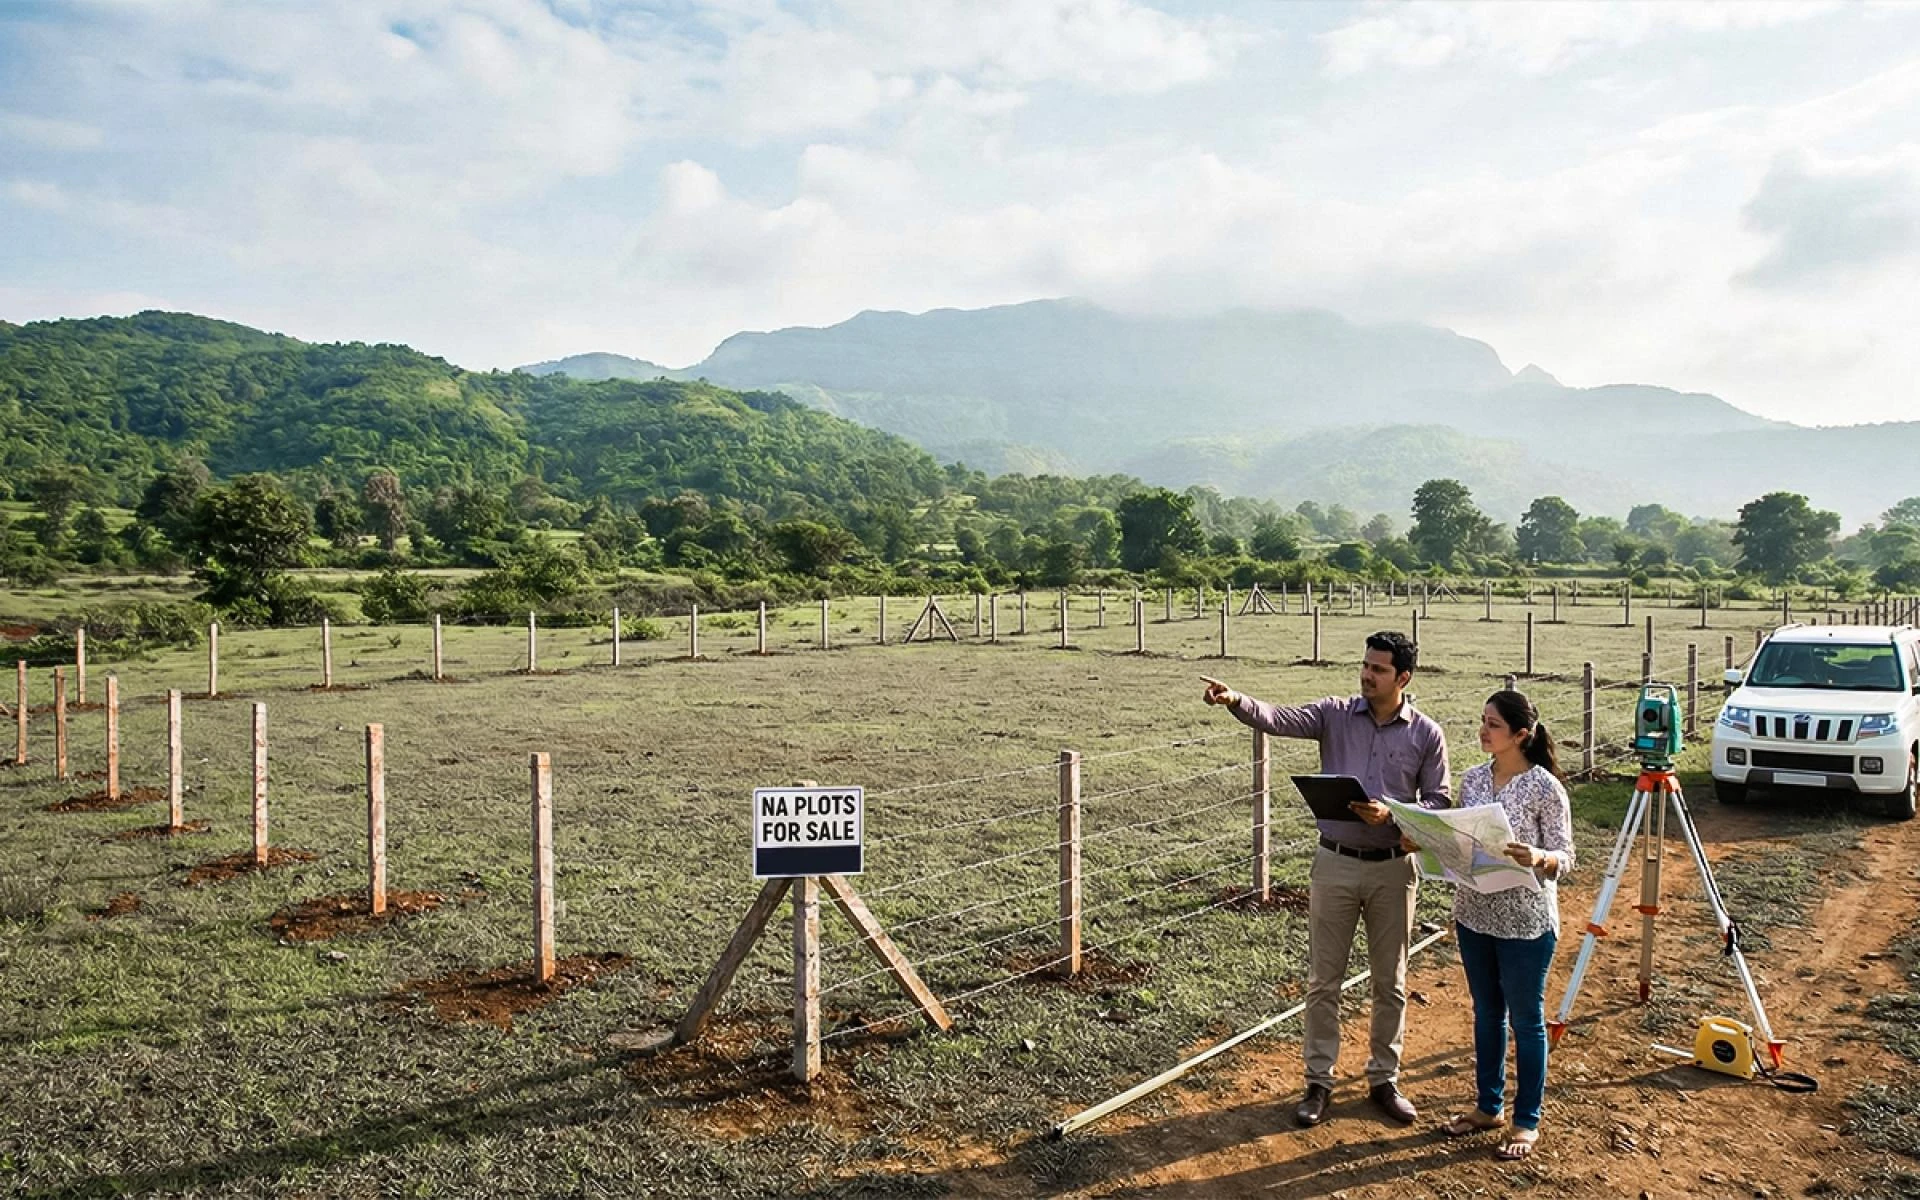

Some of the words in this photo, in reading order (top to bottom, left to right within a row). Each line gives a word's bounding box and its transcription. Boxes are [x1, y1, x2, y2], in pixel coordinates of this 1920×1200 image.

[762, 796, 788, 816] NA
[794, 795, 855, 816] PLOTS
[762, 822, 800, 842] FOR
[806, 821, 854, 841] SALE
